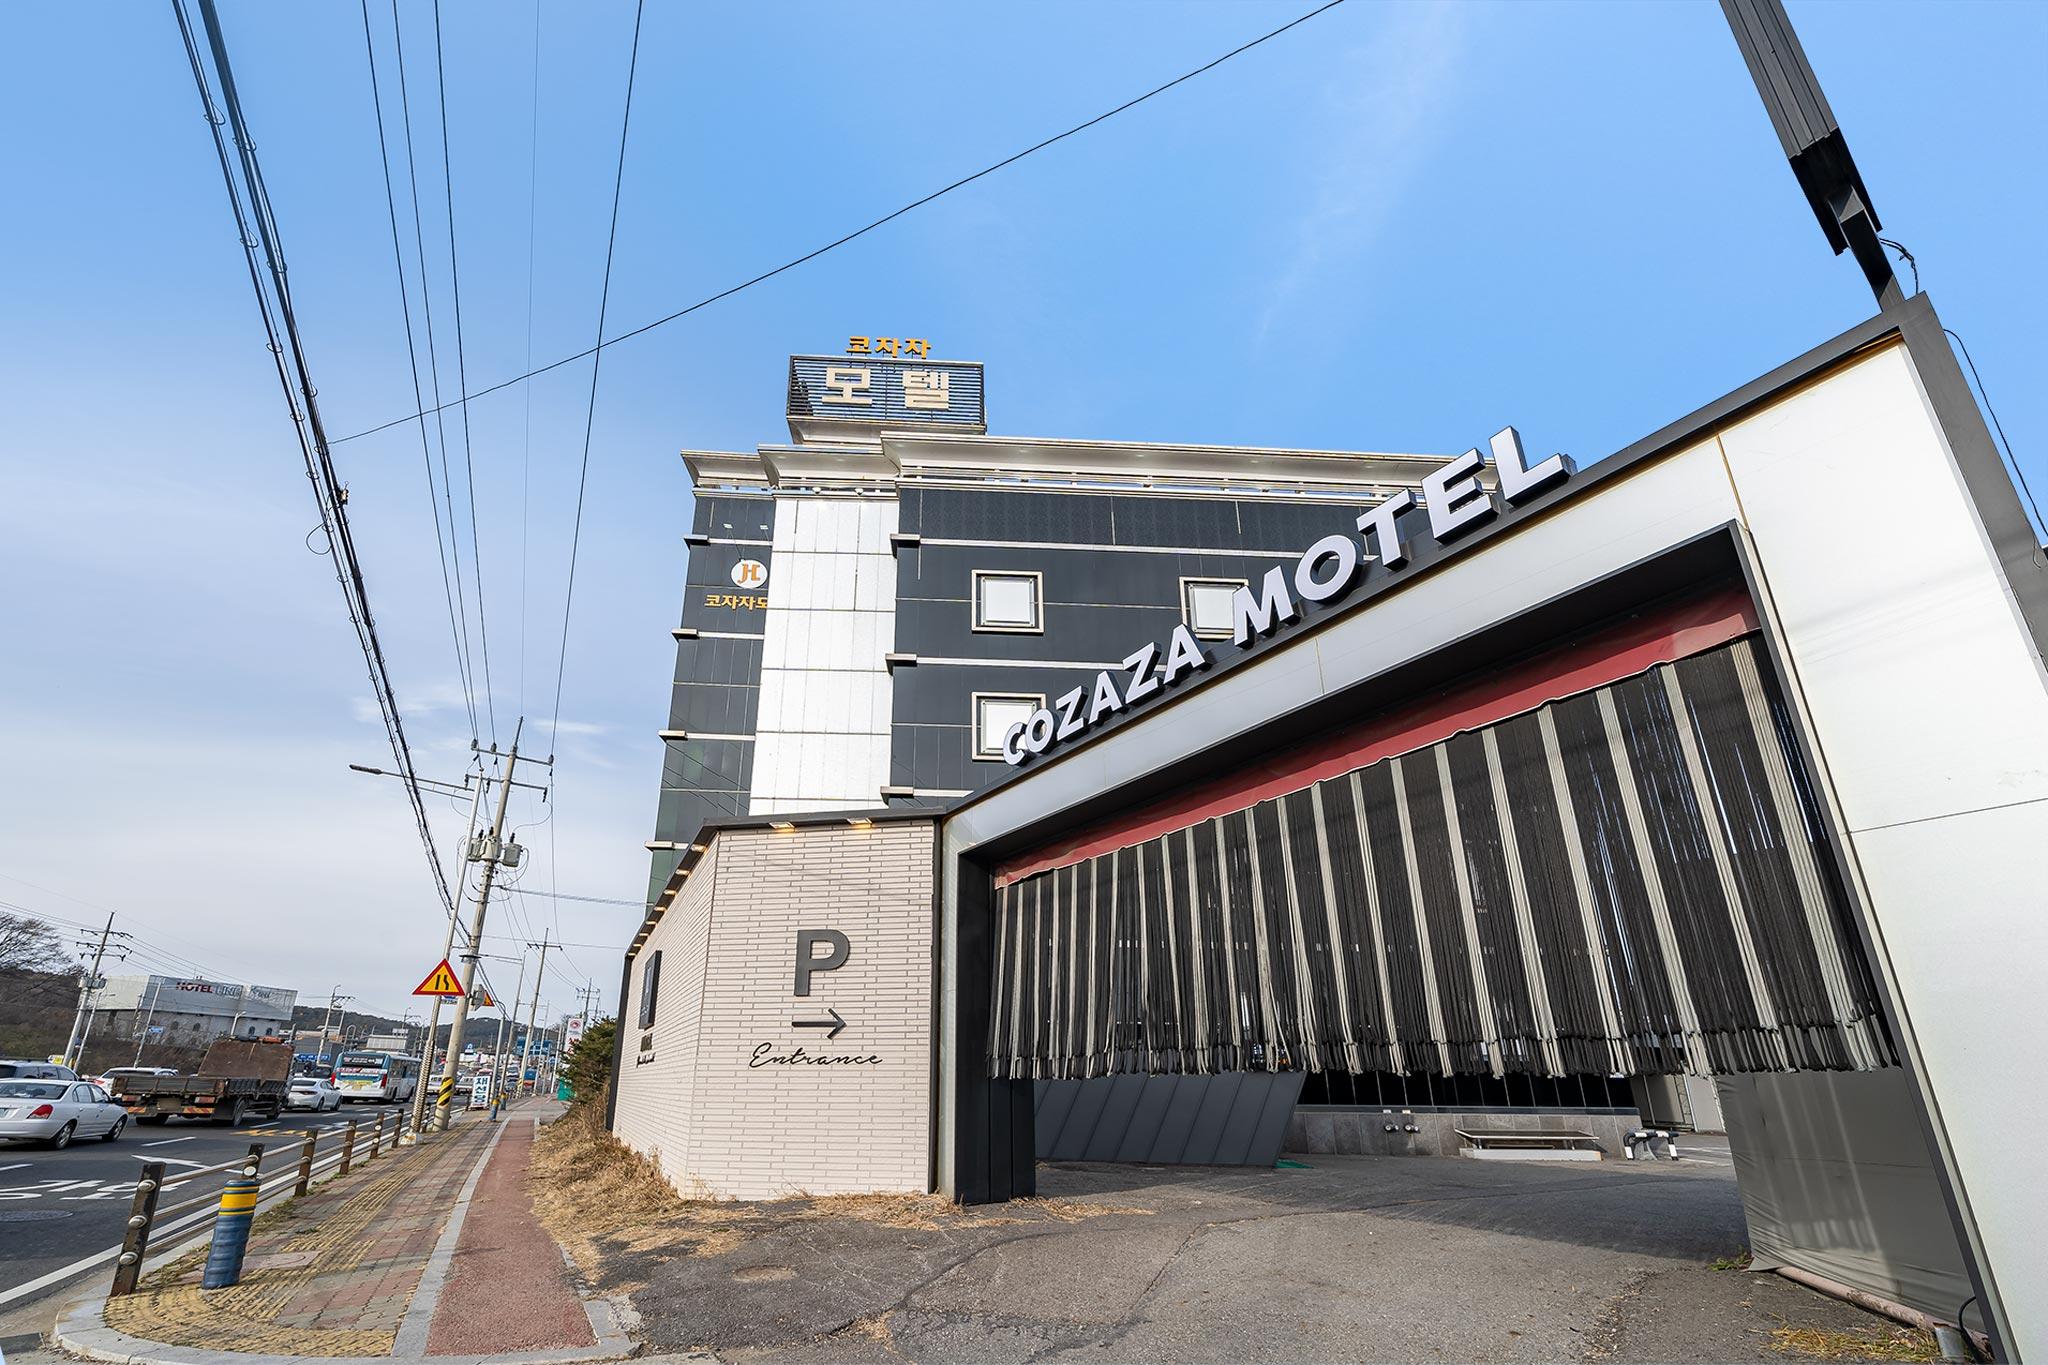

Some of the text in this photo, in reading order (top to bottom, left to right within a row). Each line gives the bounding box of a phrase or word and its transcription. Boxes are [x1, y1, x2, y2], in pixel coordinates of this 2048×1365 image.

[846, 336, 932, 359] 코자자
[822, 367, 949, 410] 모텔
[1002, 426, 1571, 766] COZAZA MOTEL
[794, 929, 850, 996] P
[176, 981, 213, 994] HOTEL
[749, 1041, 883, 1068] Entrance
